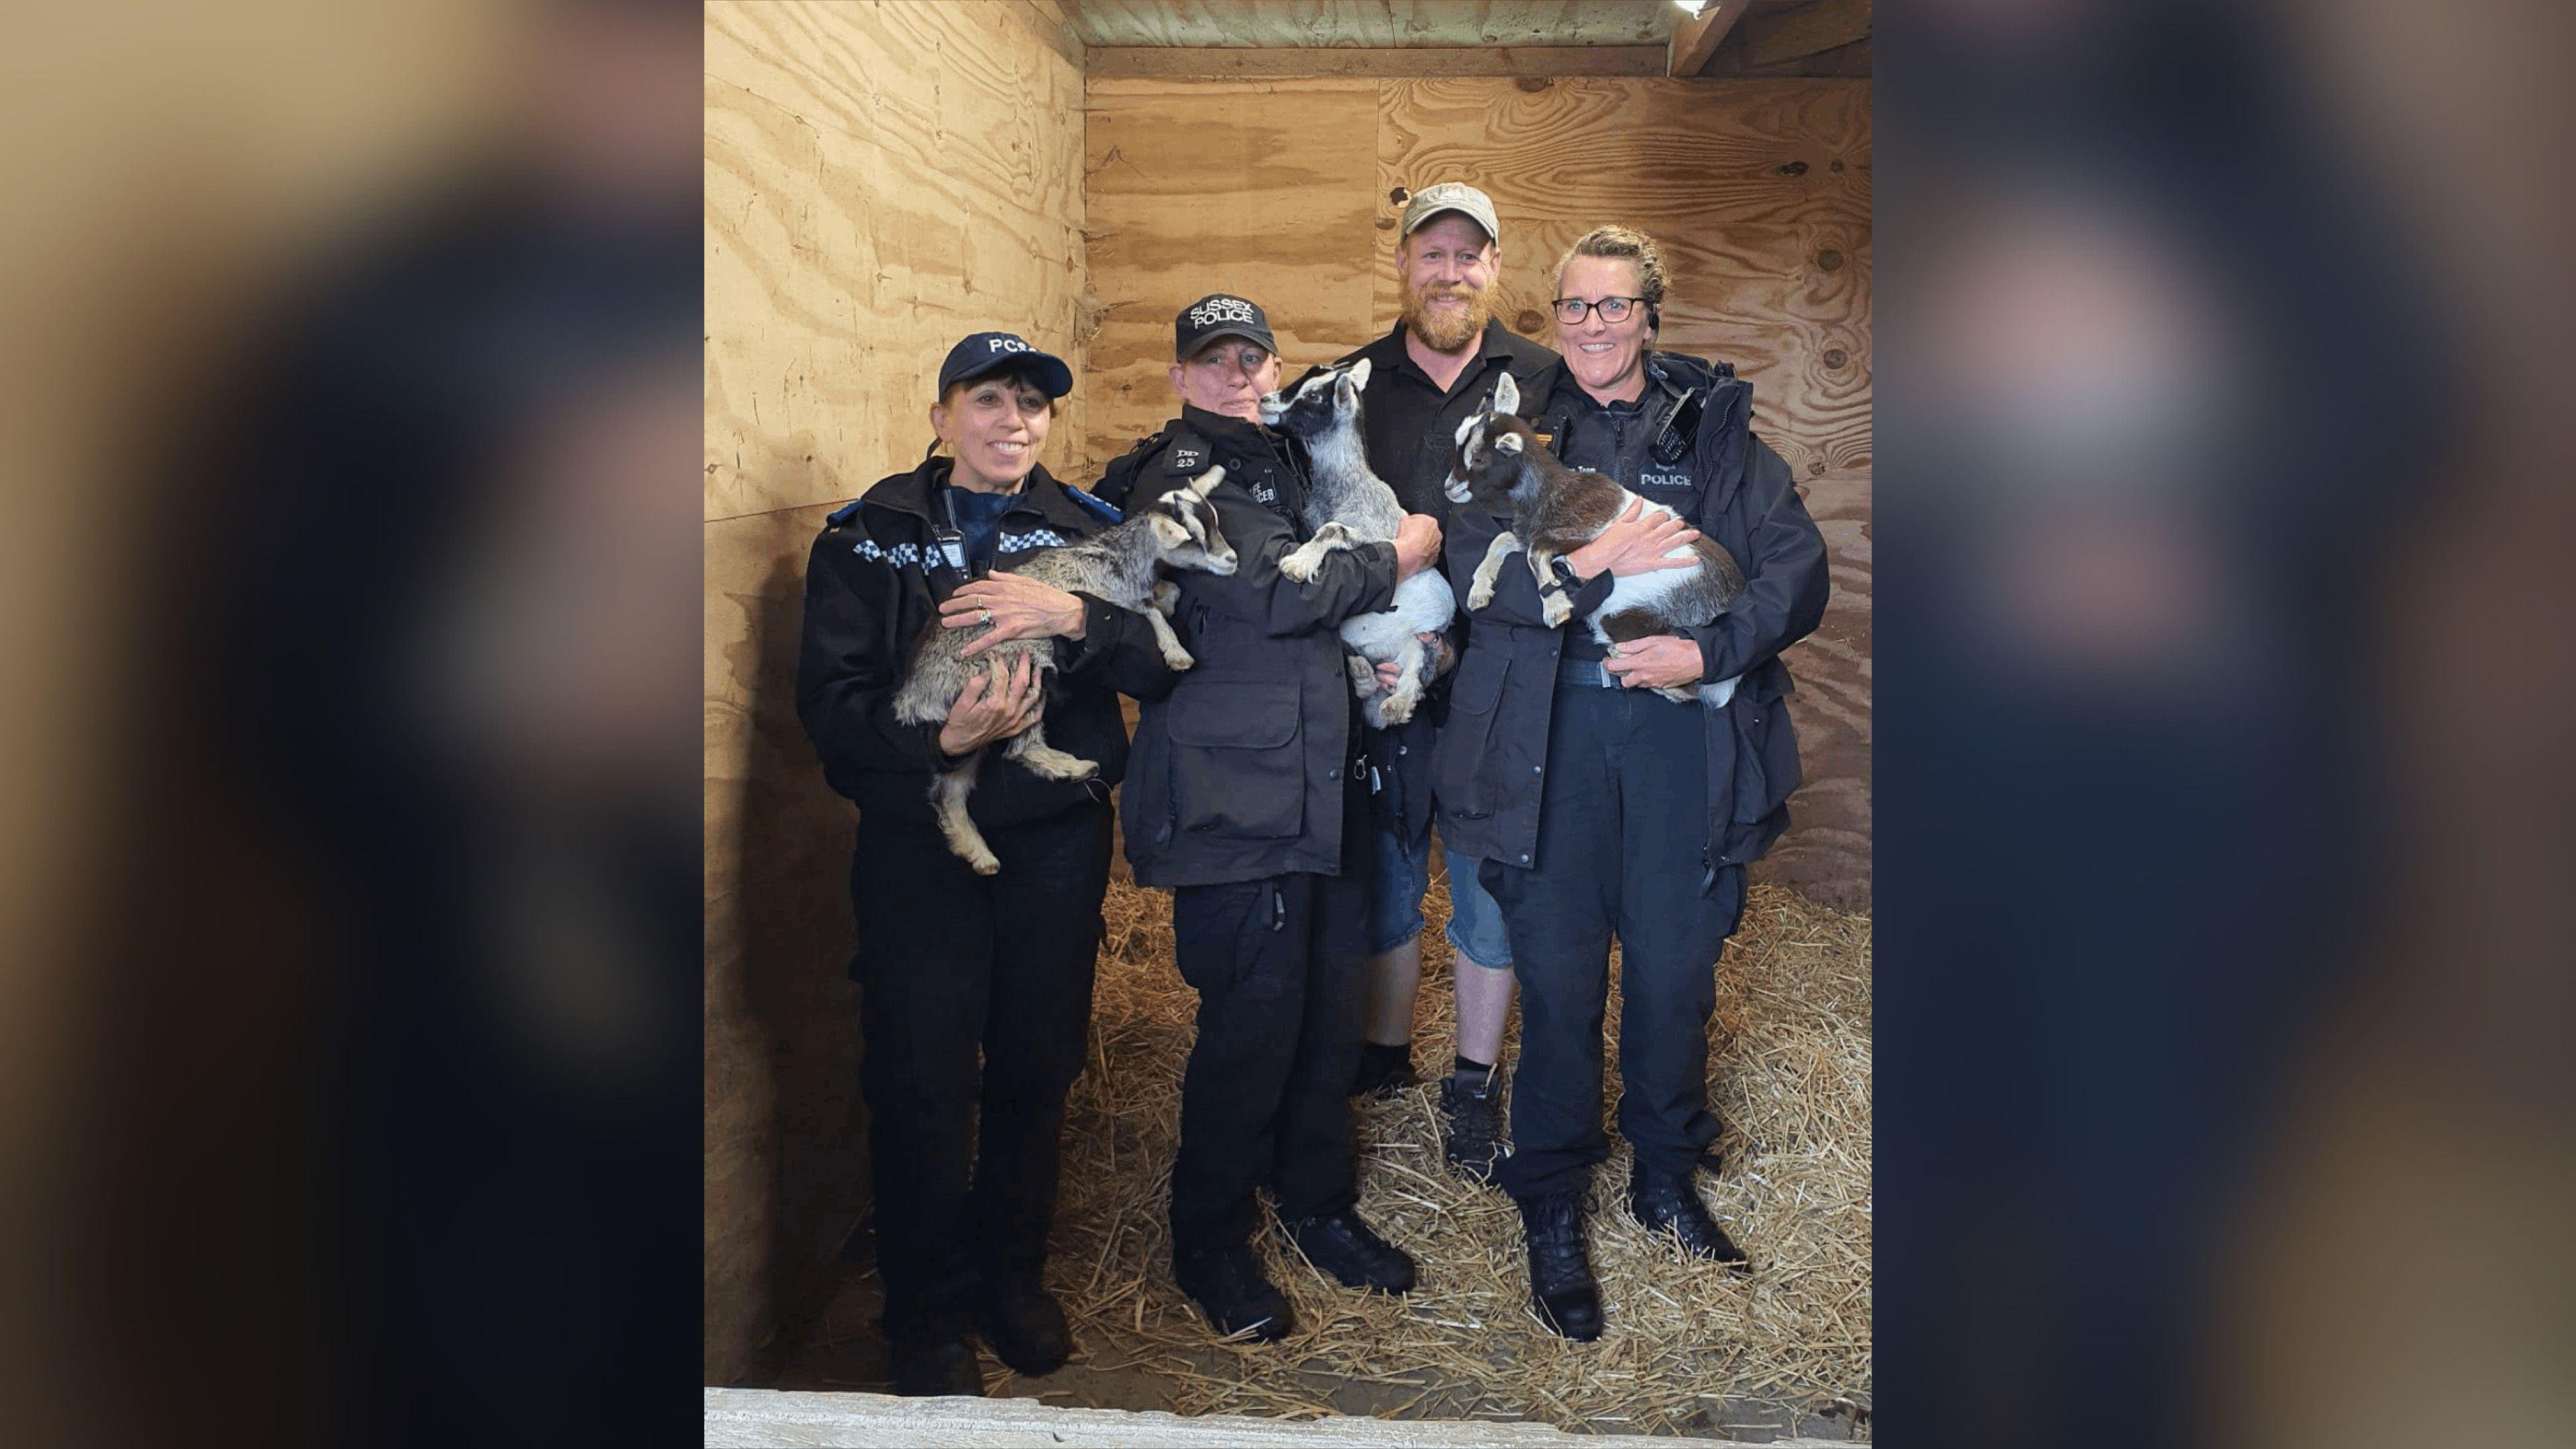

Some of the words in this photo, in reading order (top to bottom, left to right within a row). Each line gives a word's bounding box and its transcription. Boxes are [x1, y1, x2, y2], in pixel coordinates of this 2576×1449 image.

[1190, 299, 1254, 319] SUSSEX
[1195, 309, 1254, 329] POLICE
[1641, 474, 1692, 486] POLICE
